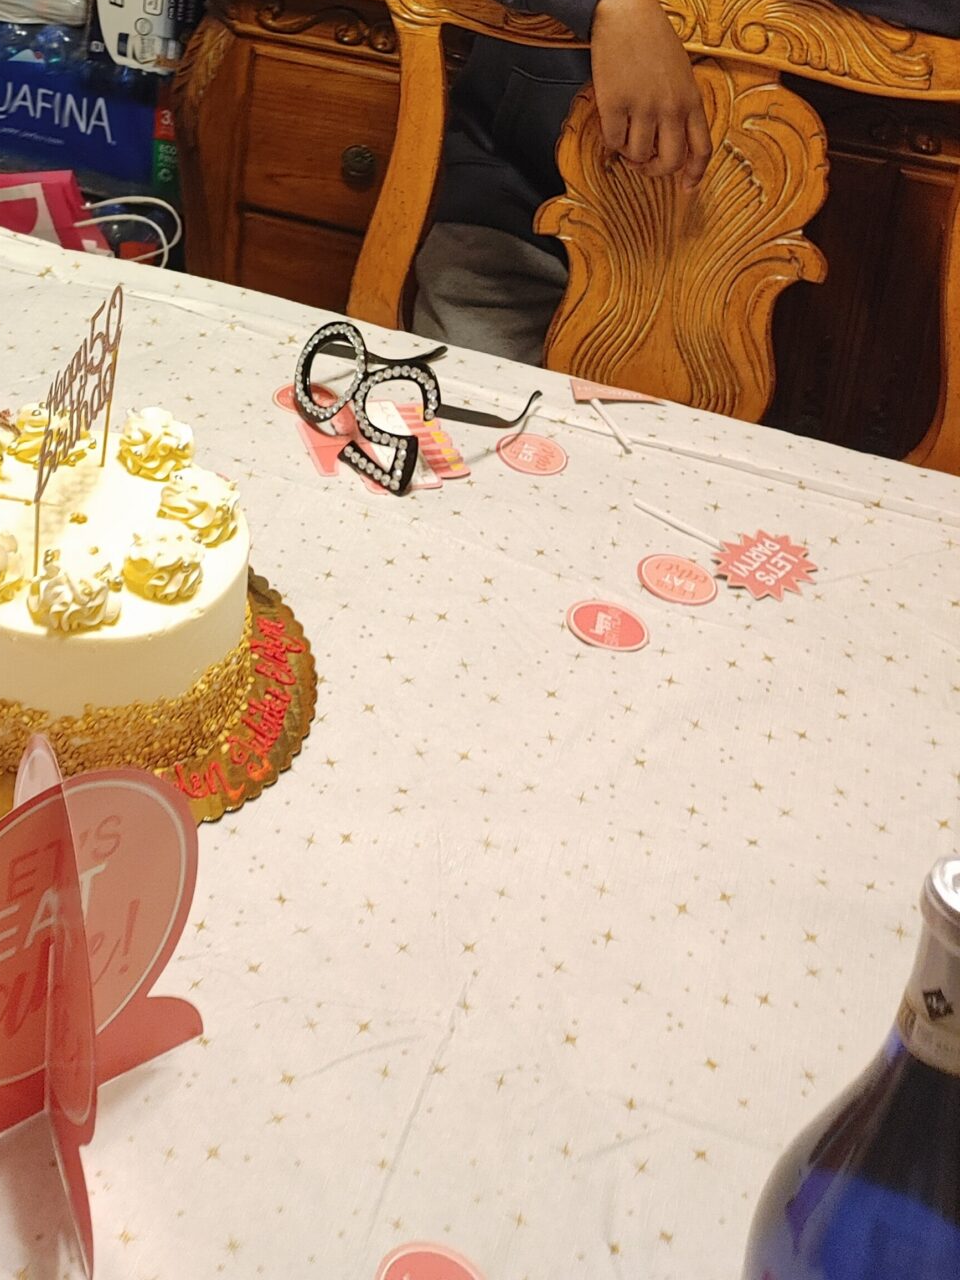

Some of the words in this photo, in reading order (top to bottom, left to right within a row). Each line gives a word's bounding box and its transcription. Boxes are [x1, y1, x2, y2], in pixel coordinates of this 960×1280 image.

[161, 111, 174, 126] 3
[89, 285, 123, 376] 50
[754, 551, 798, 586] LET'S
